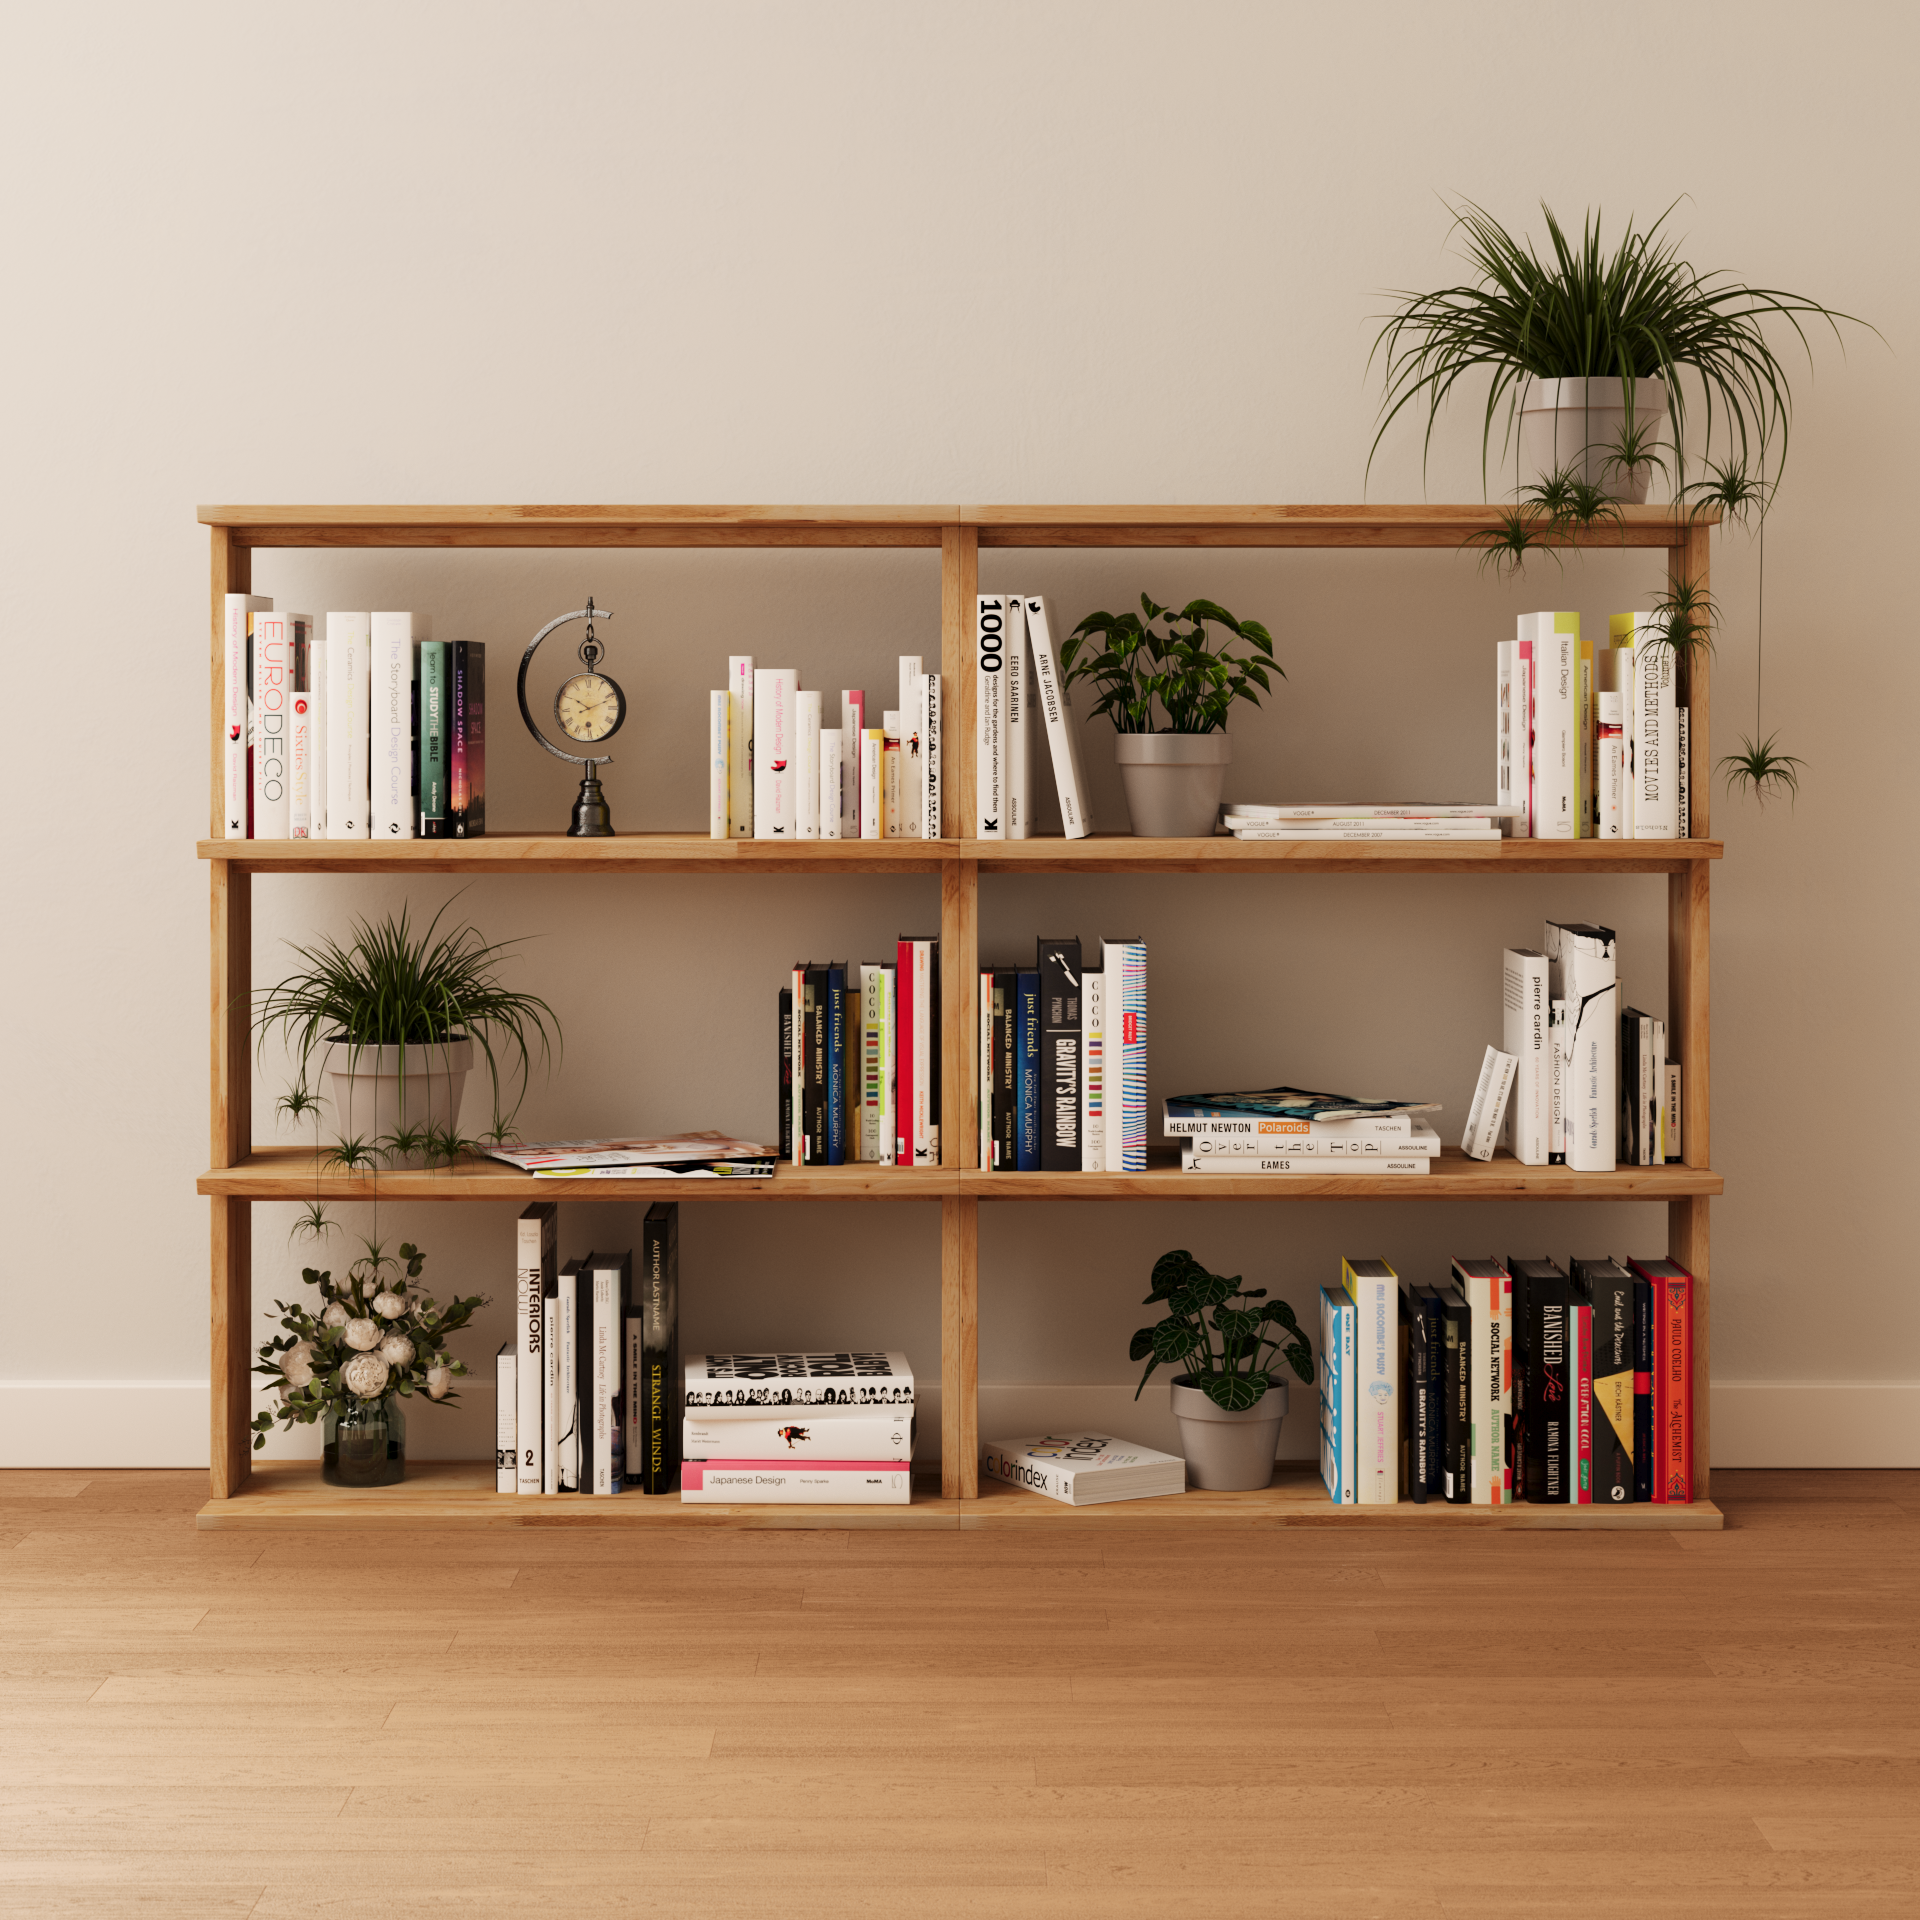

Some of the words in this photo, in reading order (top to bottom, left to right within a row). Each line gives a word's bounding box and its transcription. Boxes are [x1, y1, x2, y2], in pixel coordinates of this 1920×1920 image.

[232, 640, 238, 648] of
[391, 639, 401, 660] The
[980, 600, 1002, 672] 1000
[1010, 656, 1019, 676] EERO
[1039, 654, 1050, 676] ARNE
[1560, 641, 1568, 666] Italian
[388, 663, 401, 724] Storyboard
[773, 679, 783, 699] History
[1558, 670, 1568, 700] Design
[1645, 656, 1658, 718] METHODS
[1010, 681, 1019, 723] SAARINEN
[1043, 680, 1058, 723] JACOBSEN
[774, 709, 783, 732] Modern
[1645, 720, 1658, 746] AND
[388, 728, 401, 763] Design
[773, 734, 783, 754] Design
[1611, 746, 1618, 754] An
[391, 767, 401, 805] Course
[1645, 750, 1658, 802] MOVIES
[1065, 797, 1074, 825] ASSOULINE
[832, 989, 842, 1010] just
[1024, 993, 1036, 1014] just
[1532, 977, 1542, 1011] pierre
[1052, 998, 1062, 1023] PYNCHON
[1067, 998, 1077, 1020] THOMAS
[834, 1013, 842, 1052] friends
[1027, 1018, 1038, 1057] friends
[1534, 1014, 1542, 1050] cardin
[1056, 1097, 1076, 1148] RAINBOW
[1170, 1123, 1208, 1133] HELMUT
[1211, 1123, 1250, 1133] NEWTON
[1259, 1123, 1309, 1133] Polaroids
[1199, 1142, 1254, 1152] Over
[1274, 1142, 1314, 1152] the
[1330, 1142, 1378, 1152] Top
[1261, 1161, 1290, 1169] EAMES
[518, 1268, 528, 1315] NOW!
[1376, 1284, 1385, 1301] MRS
[529, 1268, 540, 1353] INTERIORS
[1614, 1308, 1624, 1320] and
[1491, 1322, 1500, 1354] SOCIAL
[1543, 1306, 1562, 1364] BANISHED
[1614, 1322, 1624, 1331] the
[1671, 1319, 1682, 1345] PAULO
[1614, 1333, 1624, 1365] Detectives
[597, 1356, 606, 1379] Cartney
[1376, 1352, 1385, 1375] PUSSY
[1672, 1348, 1682, 1382] COELHO
[1491, 1357, 1500, 1402] NETWORK
[1580, 1378, 1589, 1426] OPERATION
[1673, 1399, 1682, 1409] The
[597, 1404, 606, 1439] Photographs
[1491, 1409, 1499, 1444] AUTHOR
[1547, 1422, 1559, 1452] RAMONA
[1580, 1429, 1589, 1450] COOL
[1669, 1411, 1682, 1462] ALCHEMIST
[526, 1450, 534, 1466] 2
[652, 1429, 661, 1473] WINDS
[1491, 1446, 1499, 1471] NAME
[710, 1476, 753, 1485] Japanese
[755, 1476, 786, 1485] Design
[986, 1454, 1048, 1490] colorindex
[1547, 1455, 1559, 1495] FLIGHTNER
